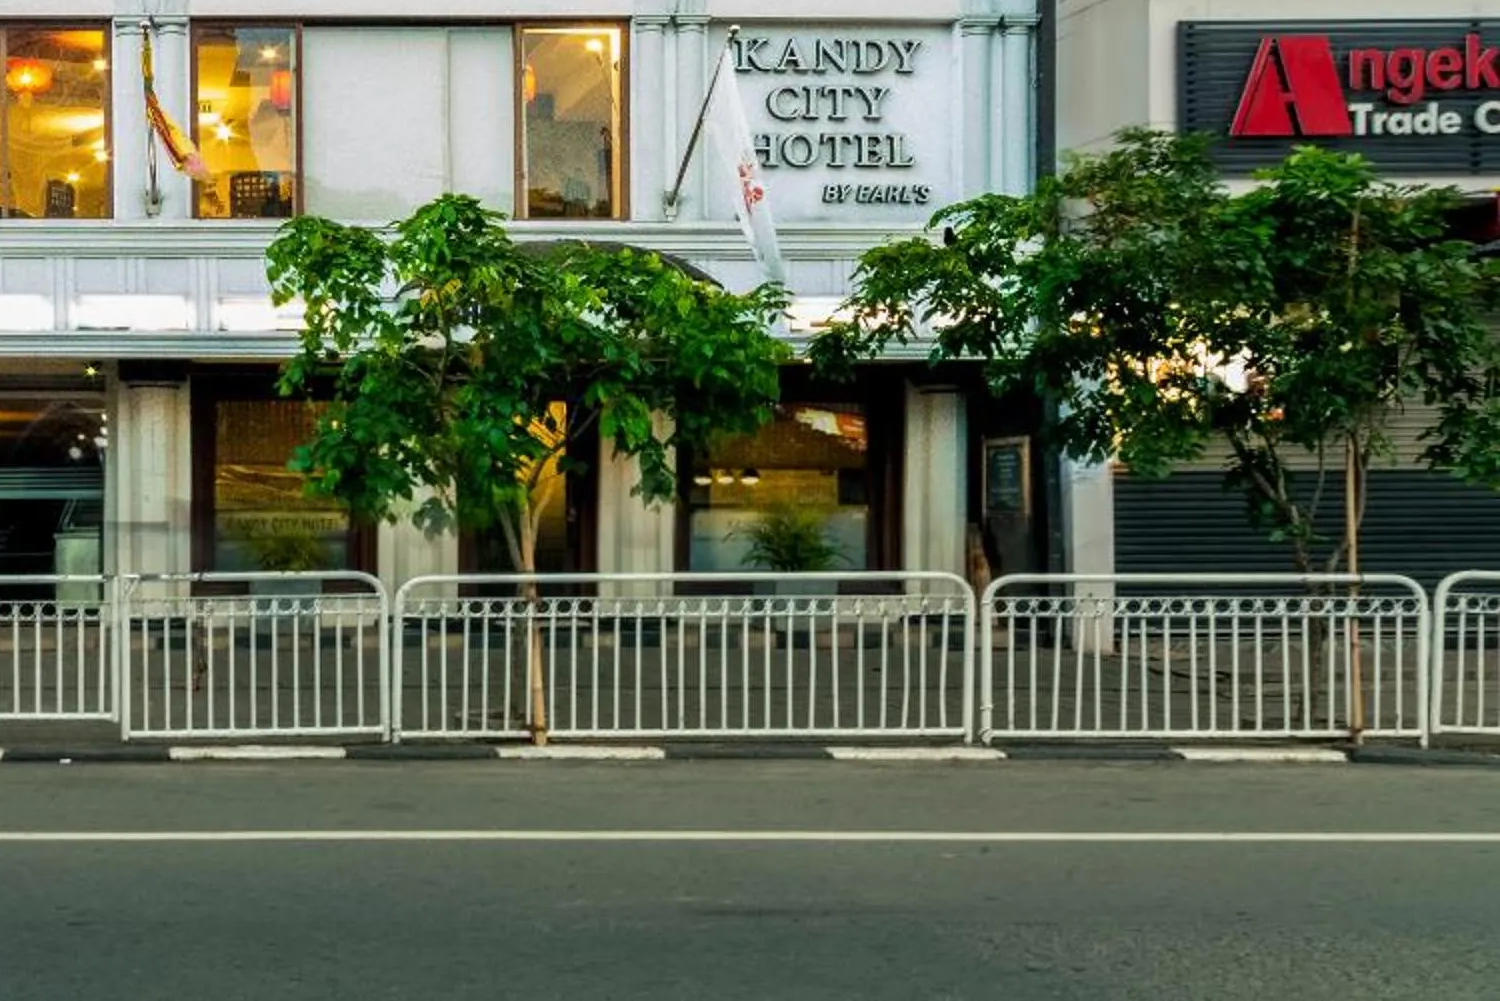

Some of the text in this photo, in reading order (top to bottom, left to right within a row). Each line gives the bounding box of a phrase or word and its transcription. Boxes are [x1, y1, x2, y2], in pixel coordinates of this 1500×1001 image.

[734, 37, 922, 74] KANDY
[766, 85, 889, 121] CITY
[1348, 102, 1462, 136] Trade
[753, 132, 915, 169] HOTEL
[822, 184, 933, 205] BY EARL'S
